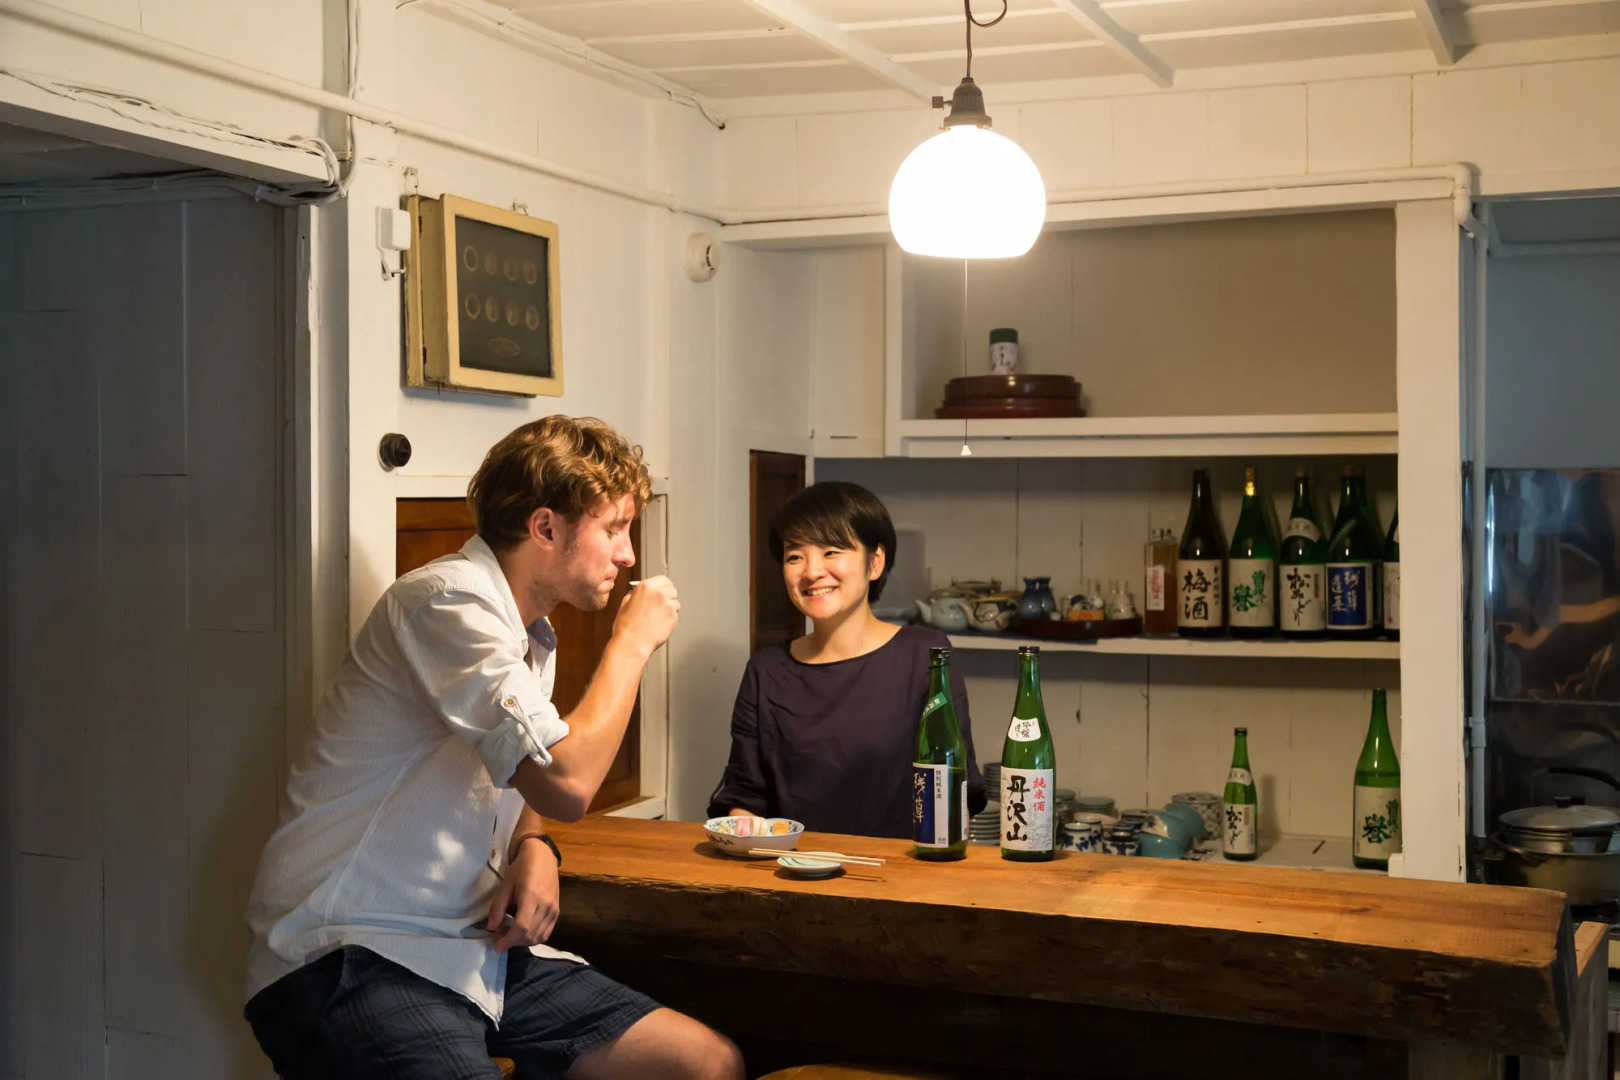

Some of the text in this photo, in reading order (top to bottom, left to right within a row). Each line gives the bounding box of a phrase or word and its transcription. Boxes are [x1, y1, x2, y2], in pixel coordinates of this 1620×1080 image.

[1181, 568, 1211, 620] 梅酒
[1006, 774, 1031, 842] 丹沢山
[1033, 776, 1047, 812] 純米酒
